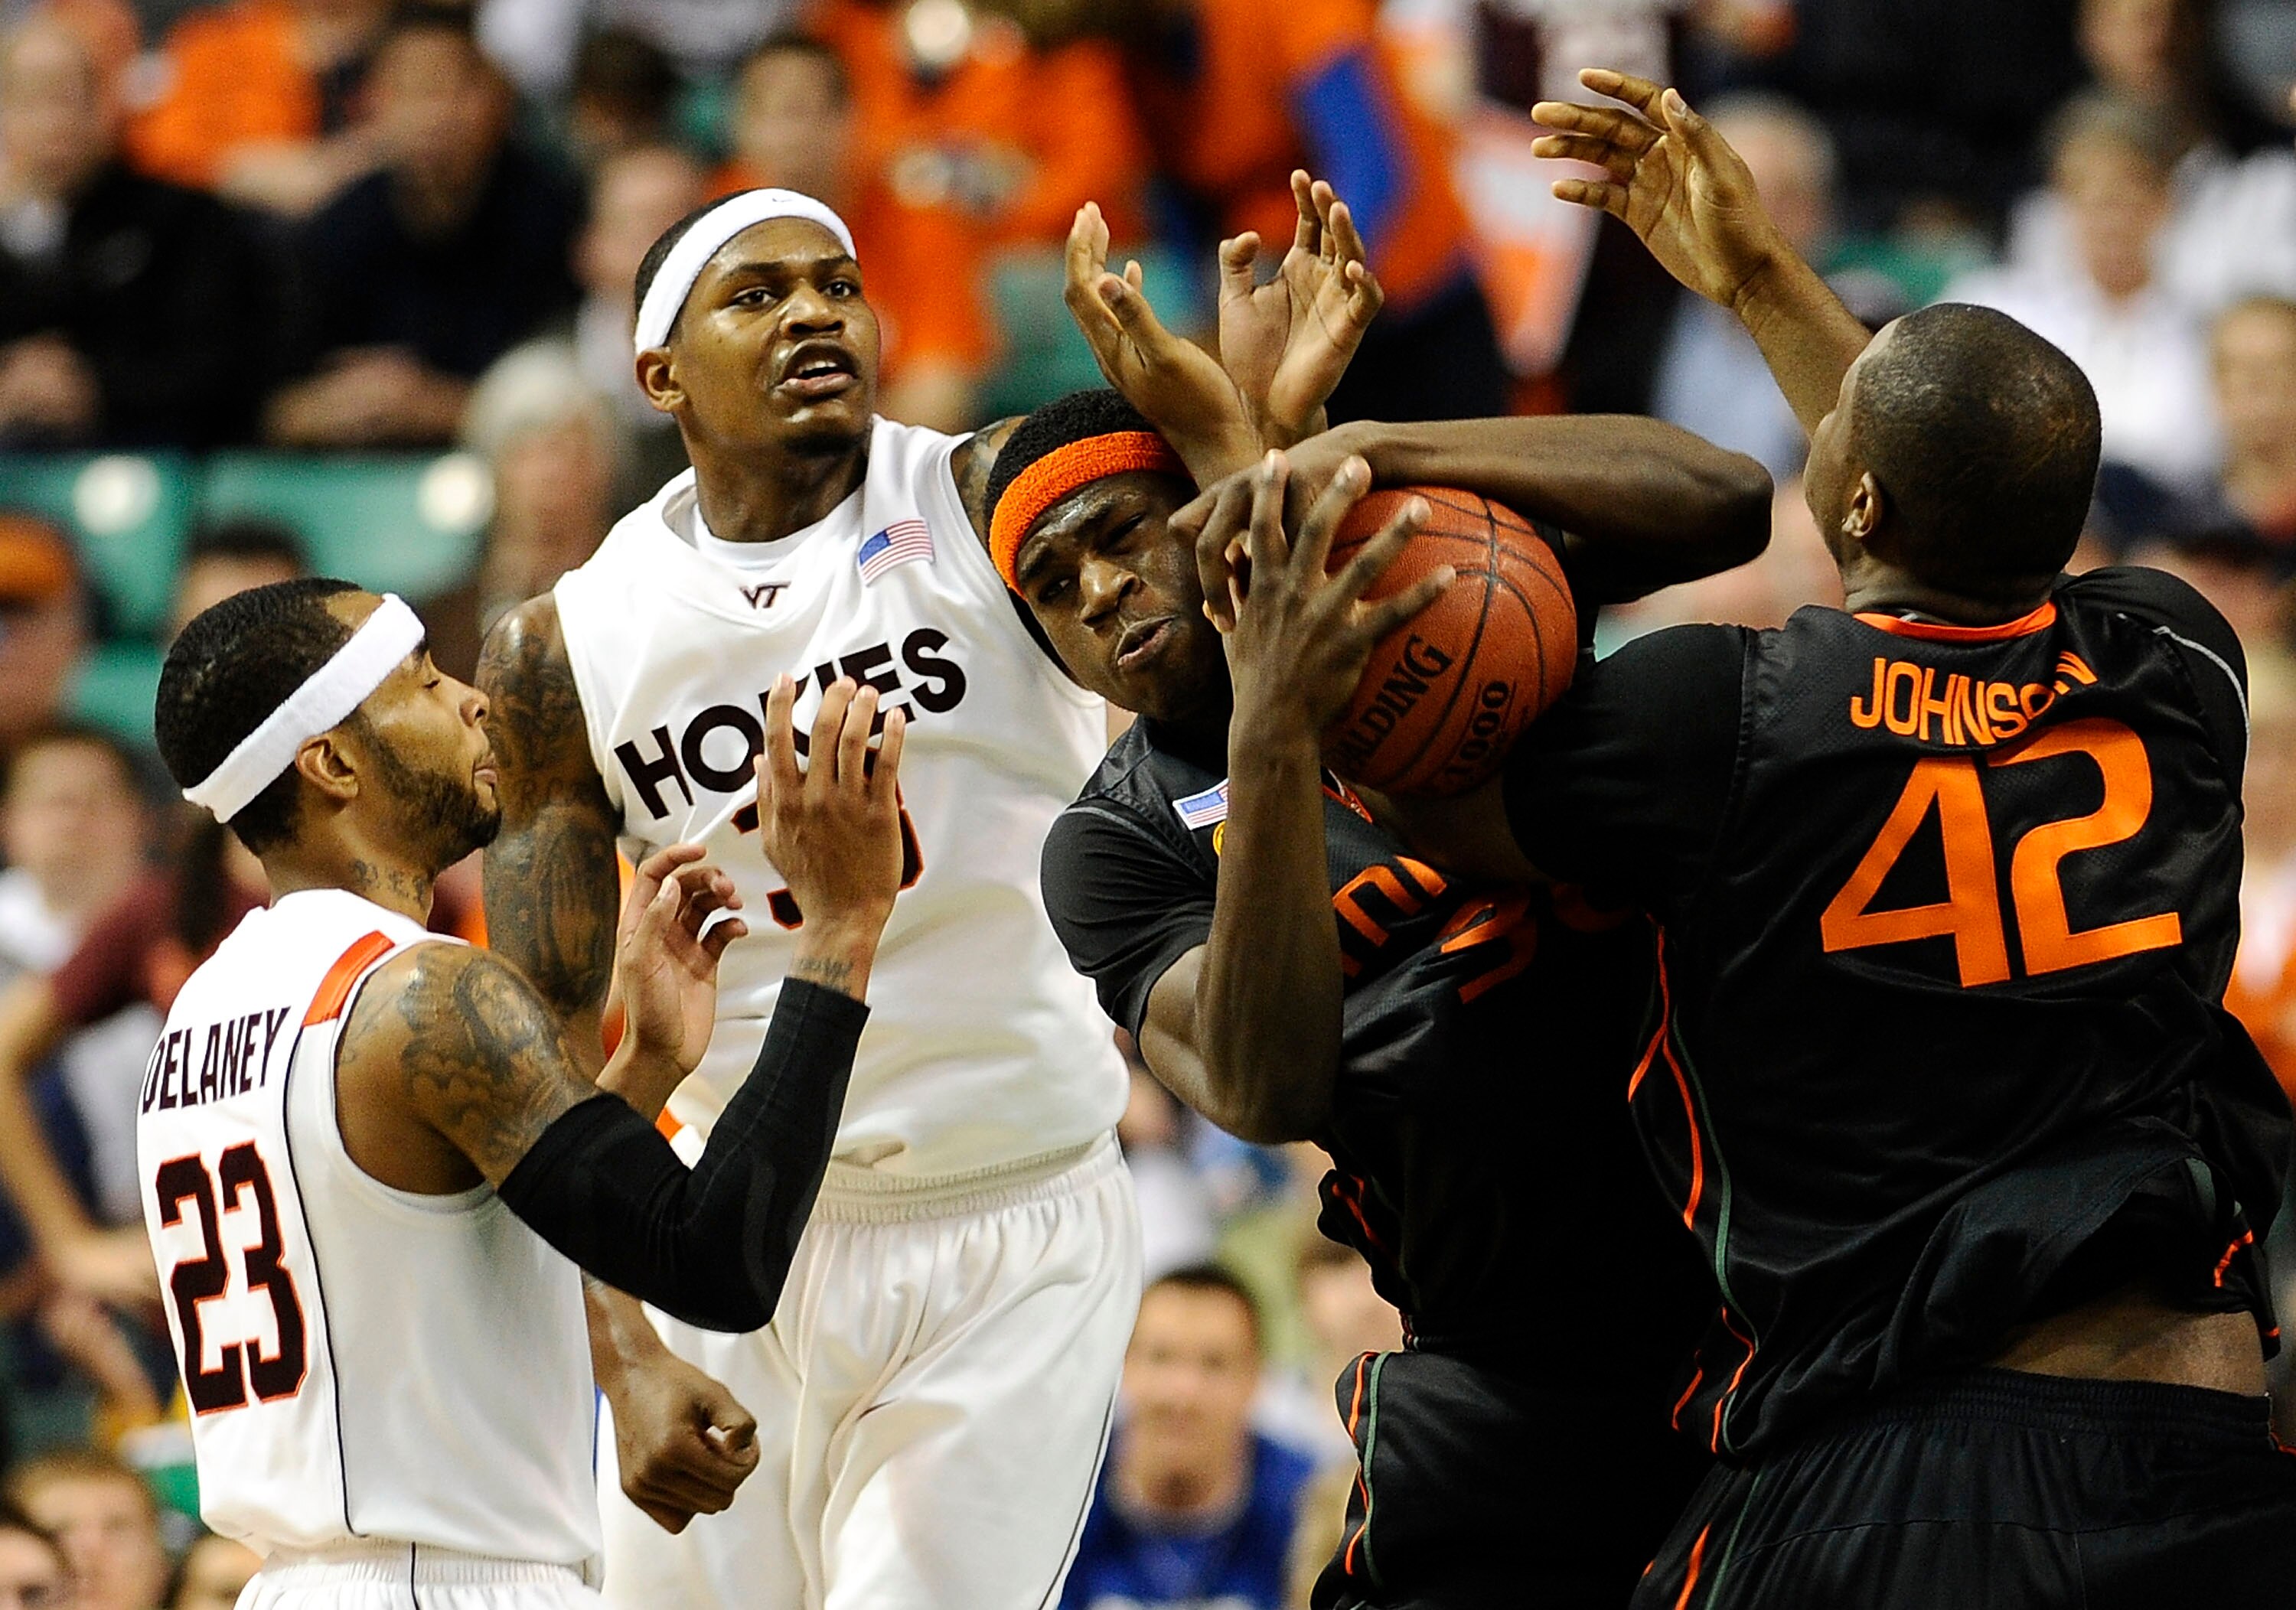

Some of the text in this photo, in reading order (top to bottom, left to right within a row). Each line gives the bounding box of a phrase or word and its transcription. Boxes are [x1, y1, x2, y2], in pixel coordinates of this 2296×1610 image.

[739, 581, 791, 610] VT
[1820, 716, 2183, 988] 42
[142, 1006, 292, 1114] DELANEY
[155, 1138, 308, 1417] 23
